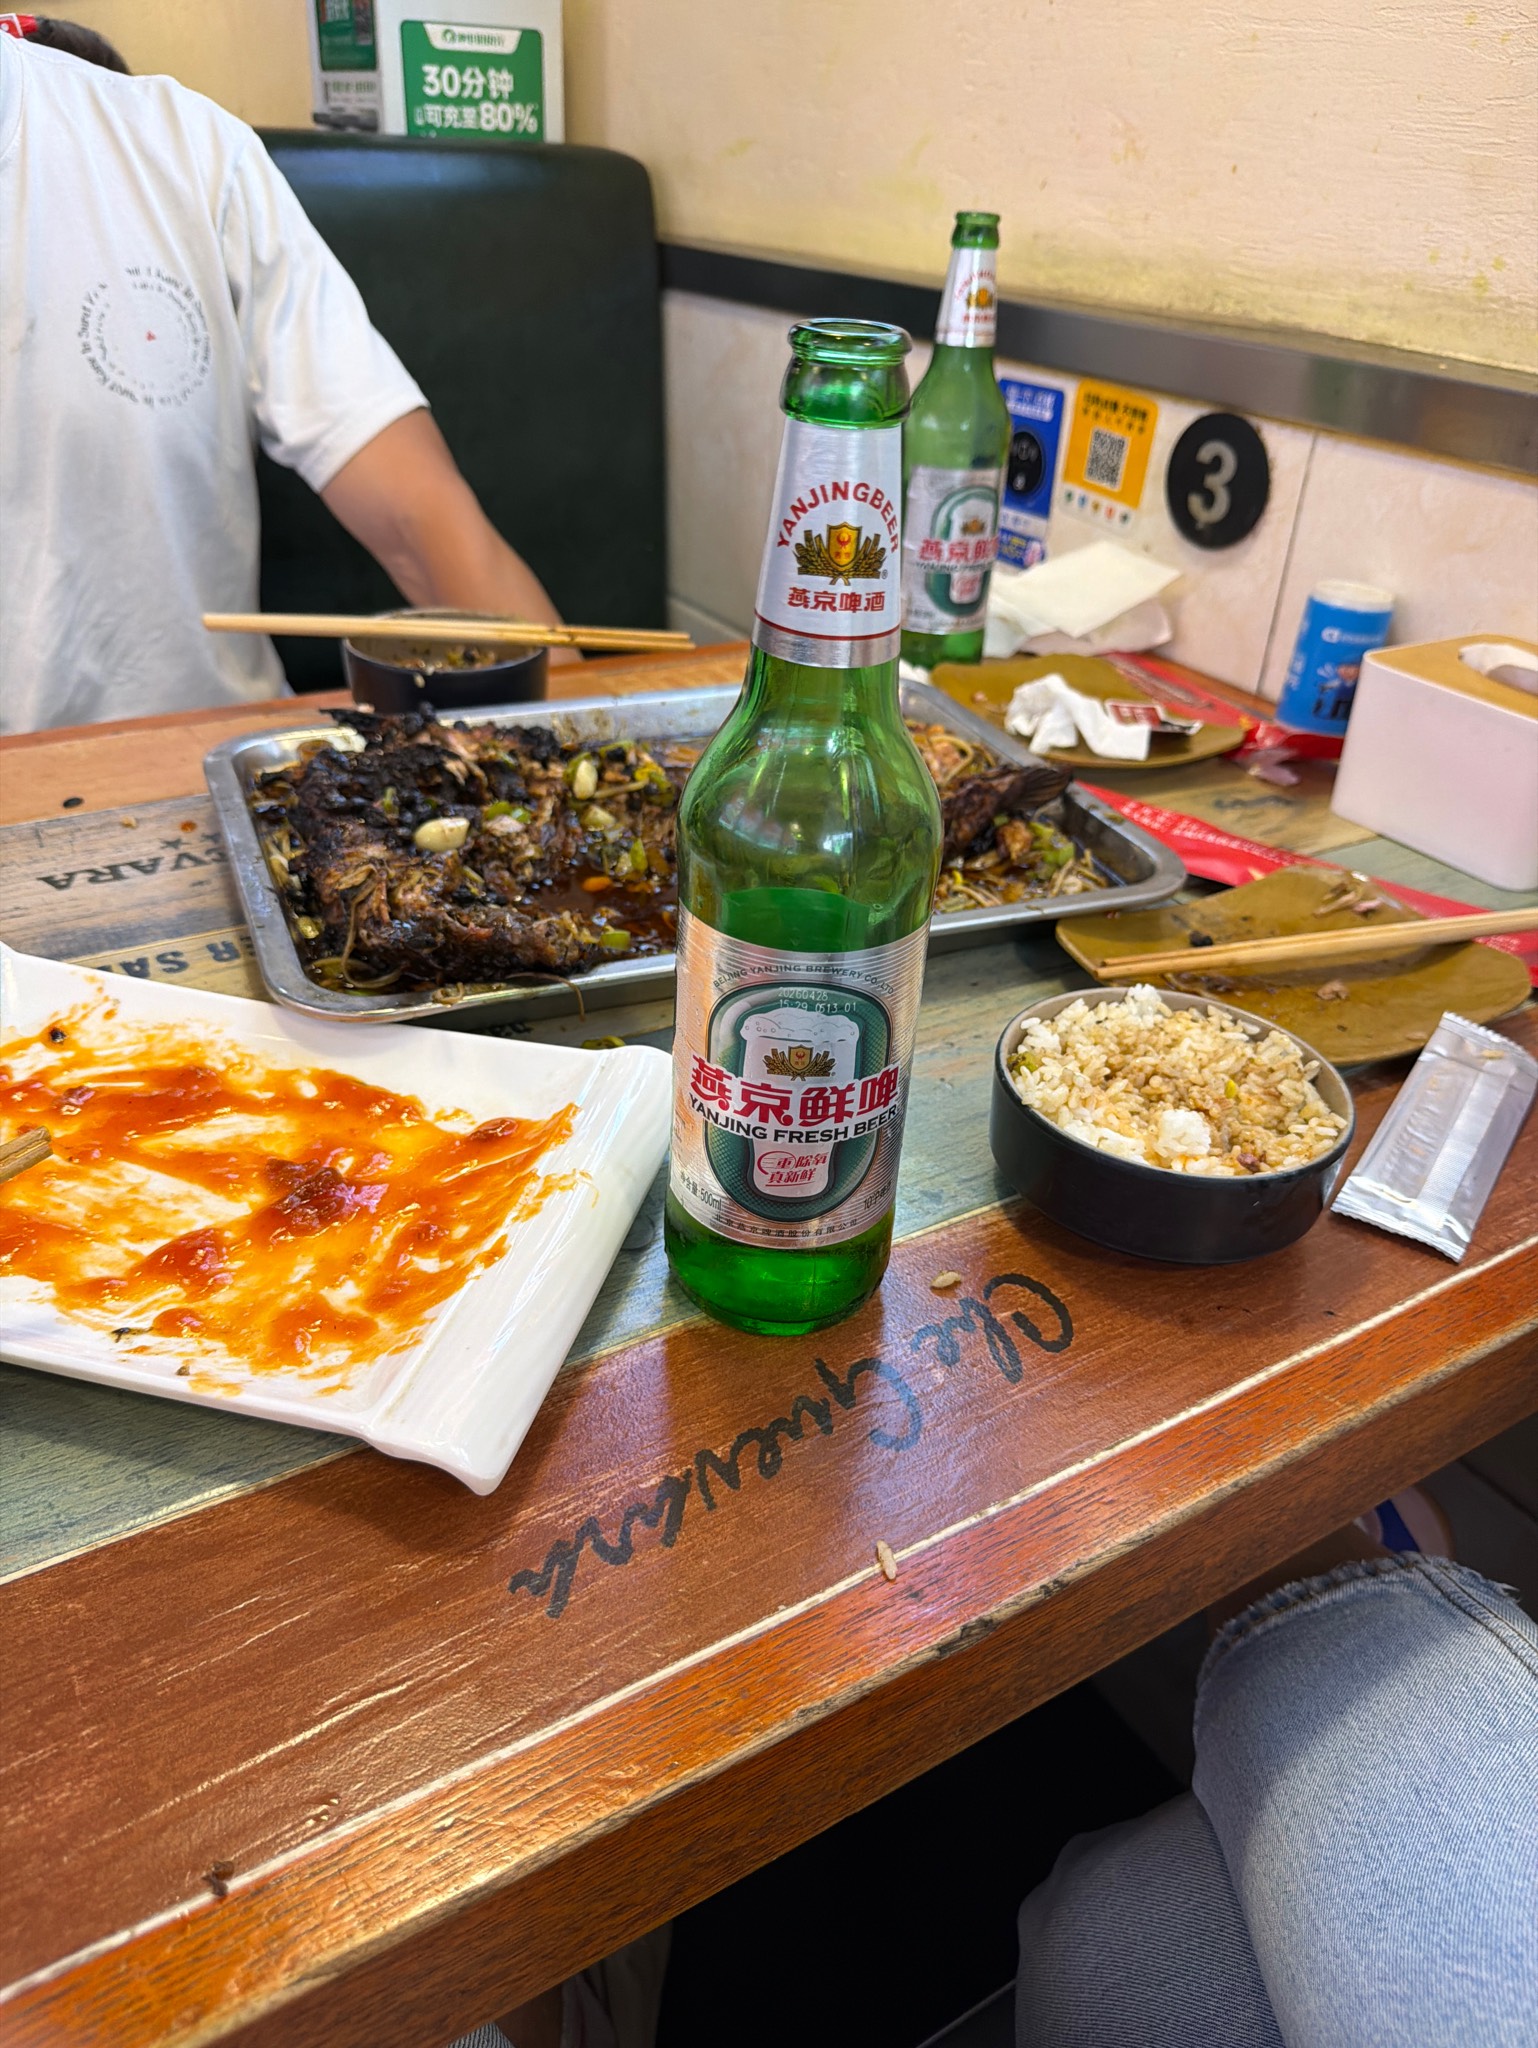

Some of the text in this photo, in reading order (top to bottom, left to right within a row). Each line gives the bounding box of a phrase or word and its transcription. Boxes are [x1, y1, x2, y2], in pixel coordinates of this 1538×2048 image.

[421, 64, 514, 100] 30分钟
[1187, 439, 1239, 525] 3
[787, 587, 886, 613] 燕京啤酒
[97, 951, 189, 978] SA
[713, 968, 748, 988] BEIJING
[750, 965, 801, 975] YANJING
[806, 965, 863, 979] BREWERY
[778, 986, 828, 1001] 20260428
[844, 1001, 857, 1013] 01
[690, 1055, 900, 1127] 燕京鲜啤
[689, 1092, 897, 1144] YANJING FRESH BEER
[911, 1273, 1074, 1384] Che
